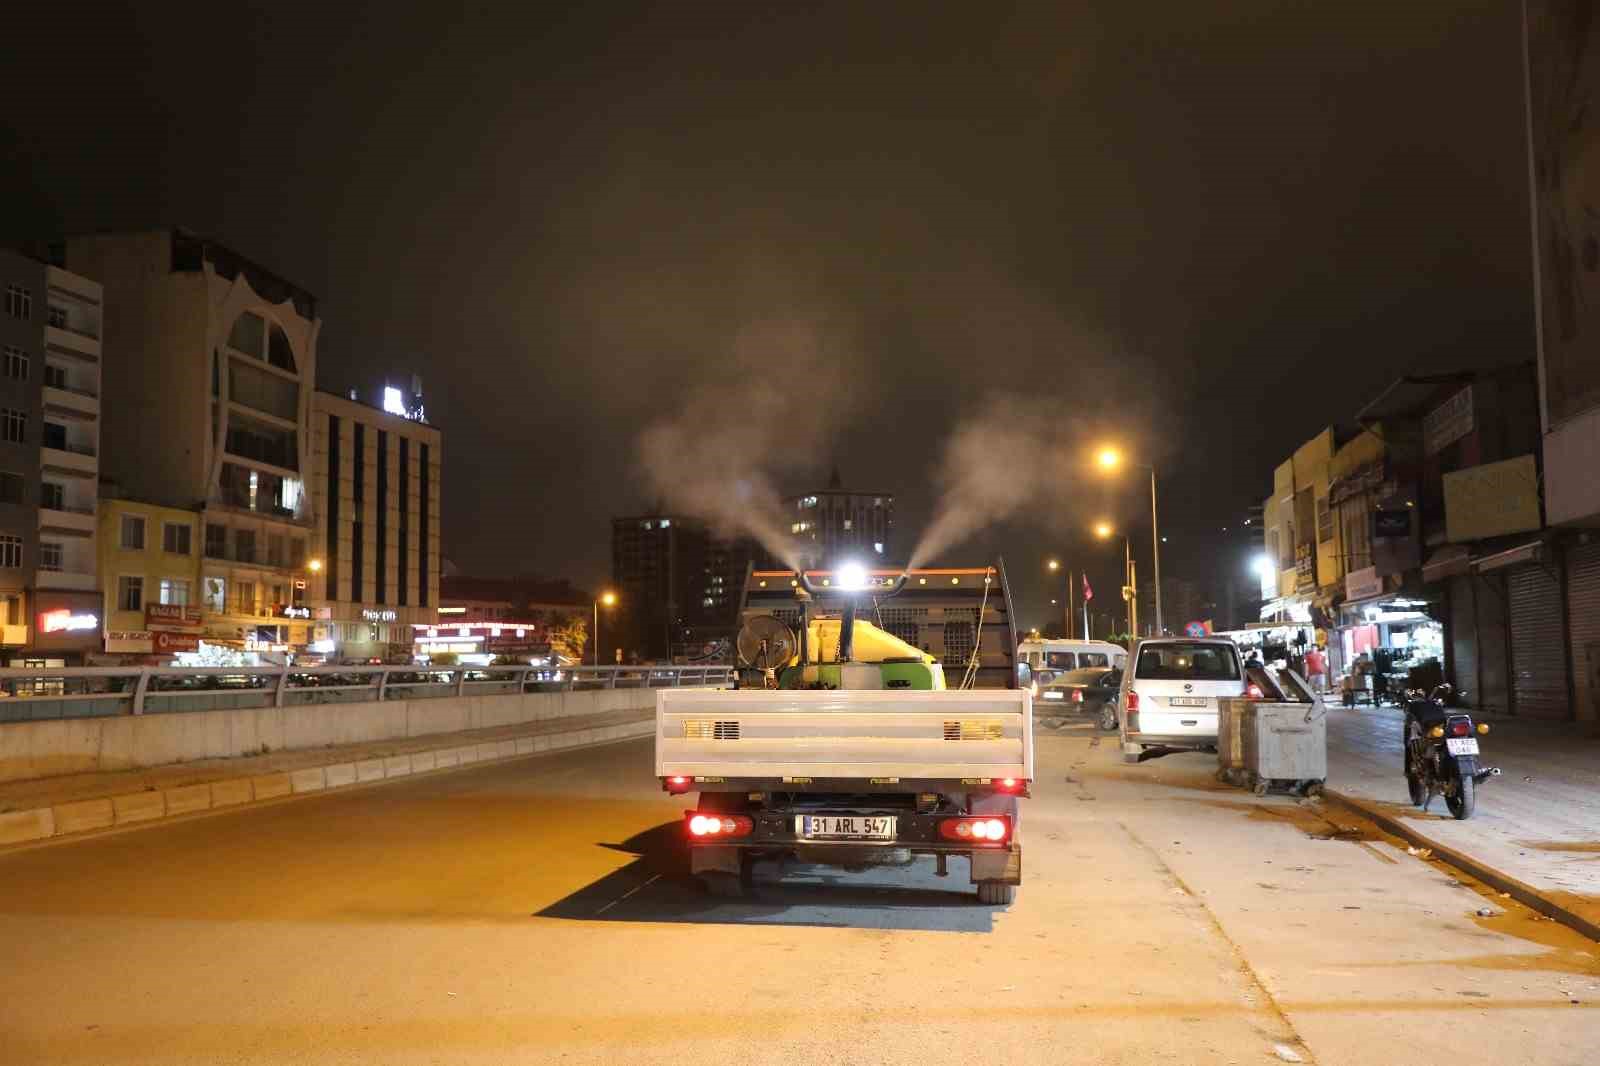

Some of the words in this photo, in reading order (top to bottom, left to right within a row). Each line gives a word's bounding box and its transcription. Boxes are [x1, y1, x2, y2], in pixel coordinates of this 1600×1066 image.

[813, 818, 828, 833] 31
[835, 818, 858, 833] ARL
[864, 818, 888, 833] 547
